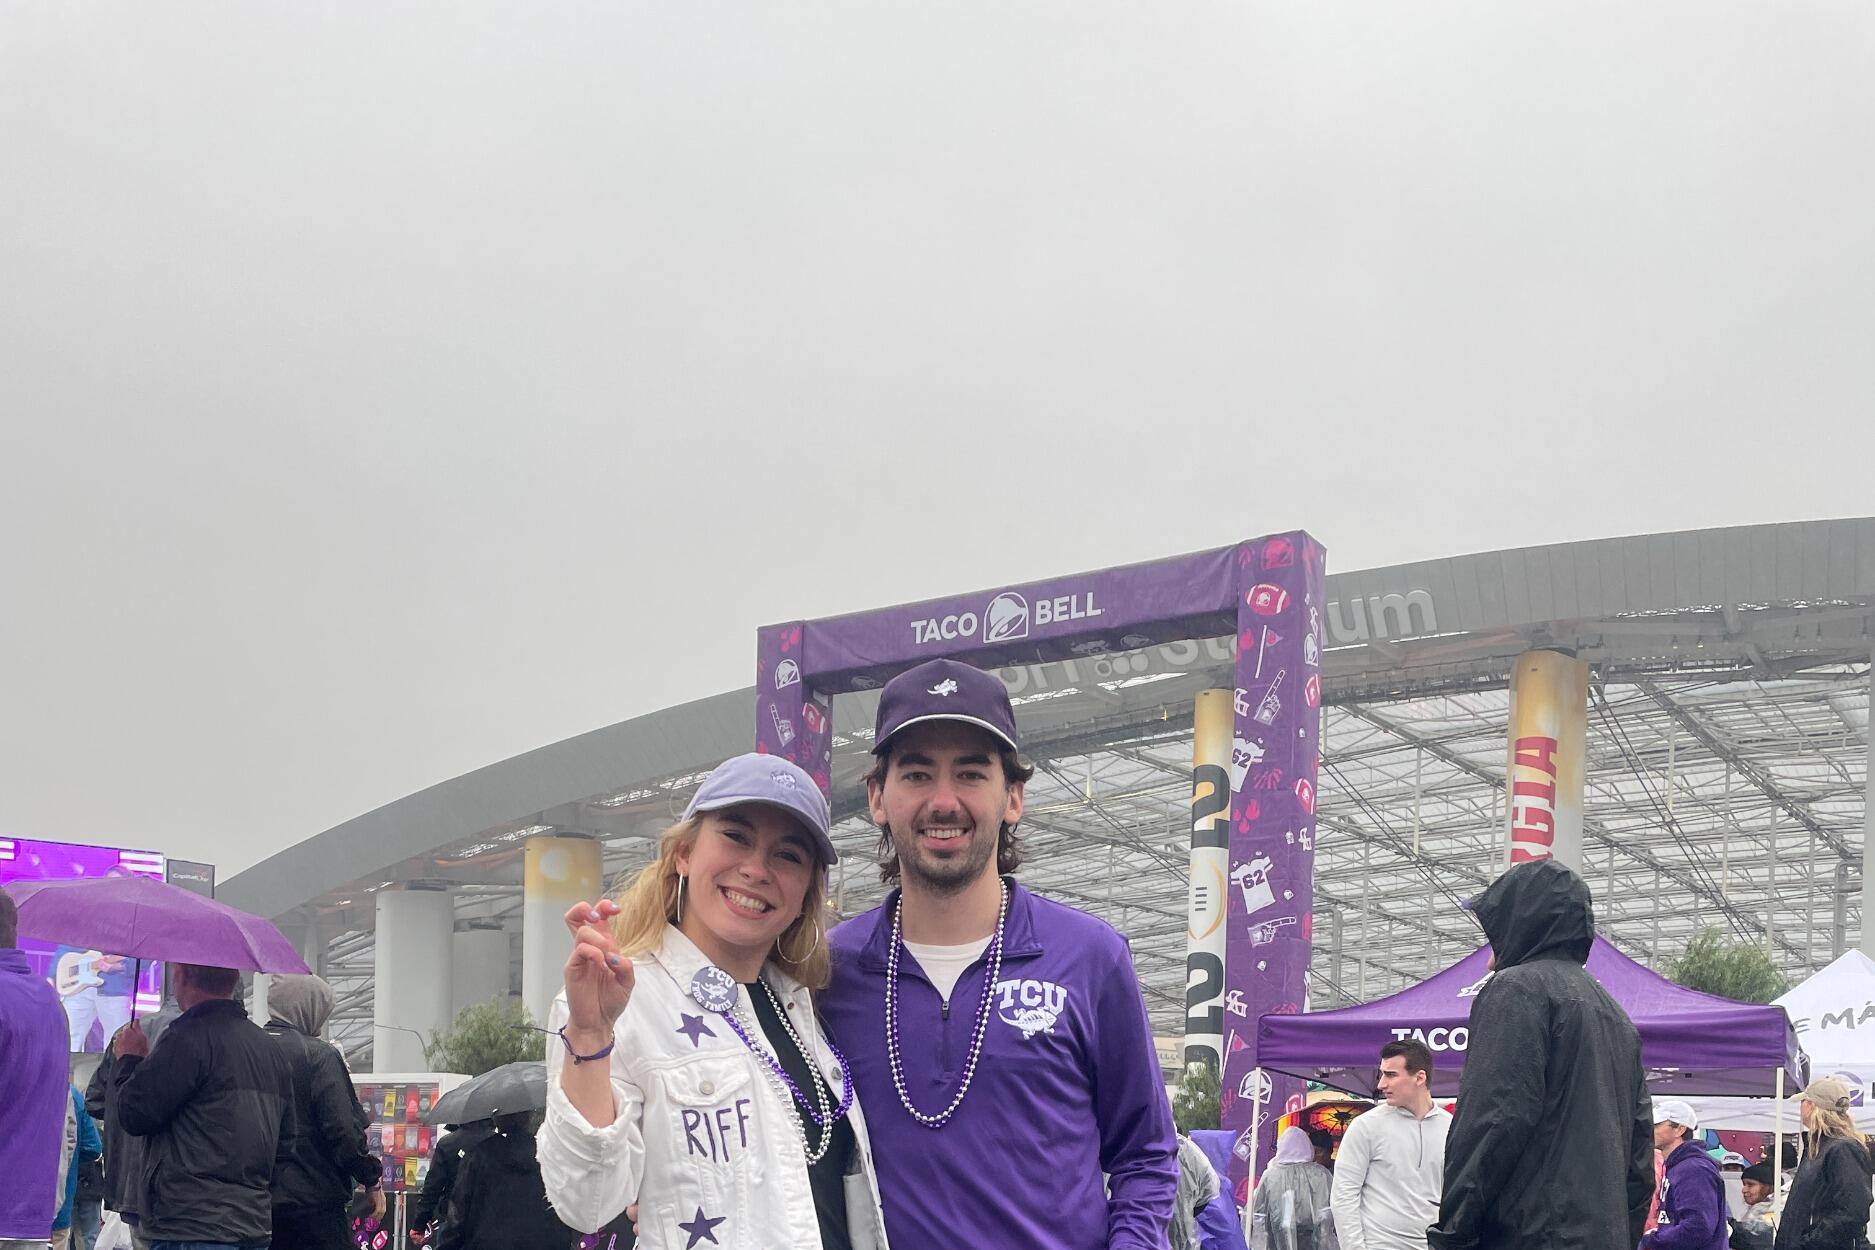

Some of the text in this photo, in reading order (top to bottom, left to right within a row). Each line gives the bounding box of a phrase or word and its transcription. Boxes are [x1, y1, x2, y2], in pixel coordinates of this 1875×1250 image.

[911, 592, 1102, 644] TACO BELL
[1231, 747, 1252, 769] 62
[1242, 869, 1266, 889] 62
[707, 966, 736, 988] TCU
[692, 980, 705, 1003] FROG
[995, 979, 1067, 1016] TCU
[704, 999, 733, 1012] FAMILY
[681, 1099, 751, 1164] RIFF
